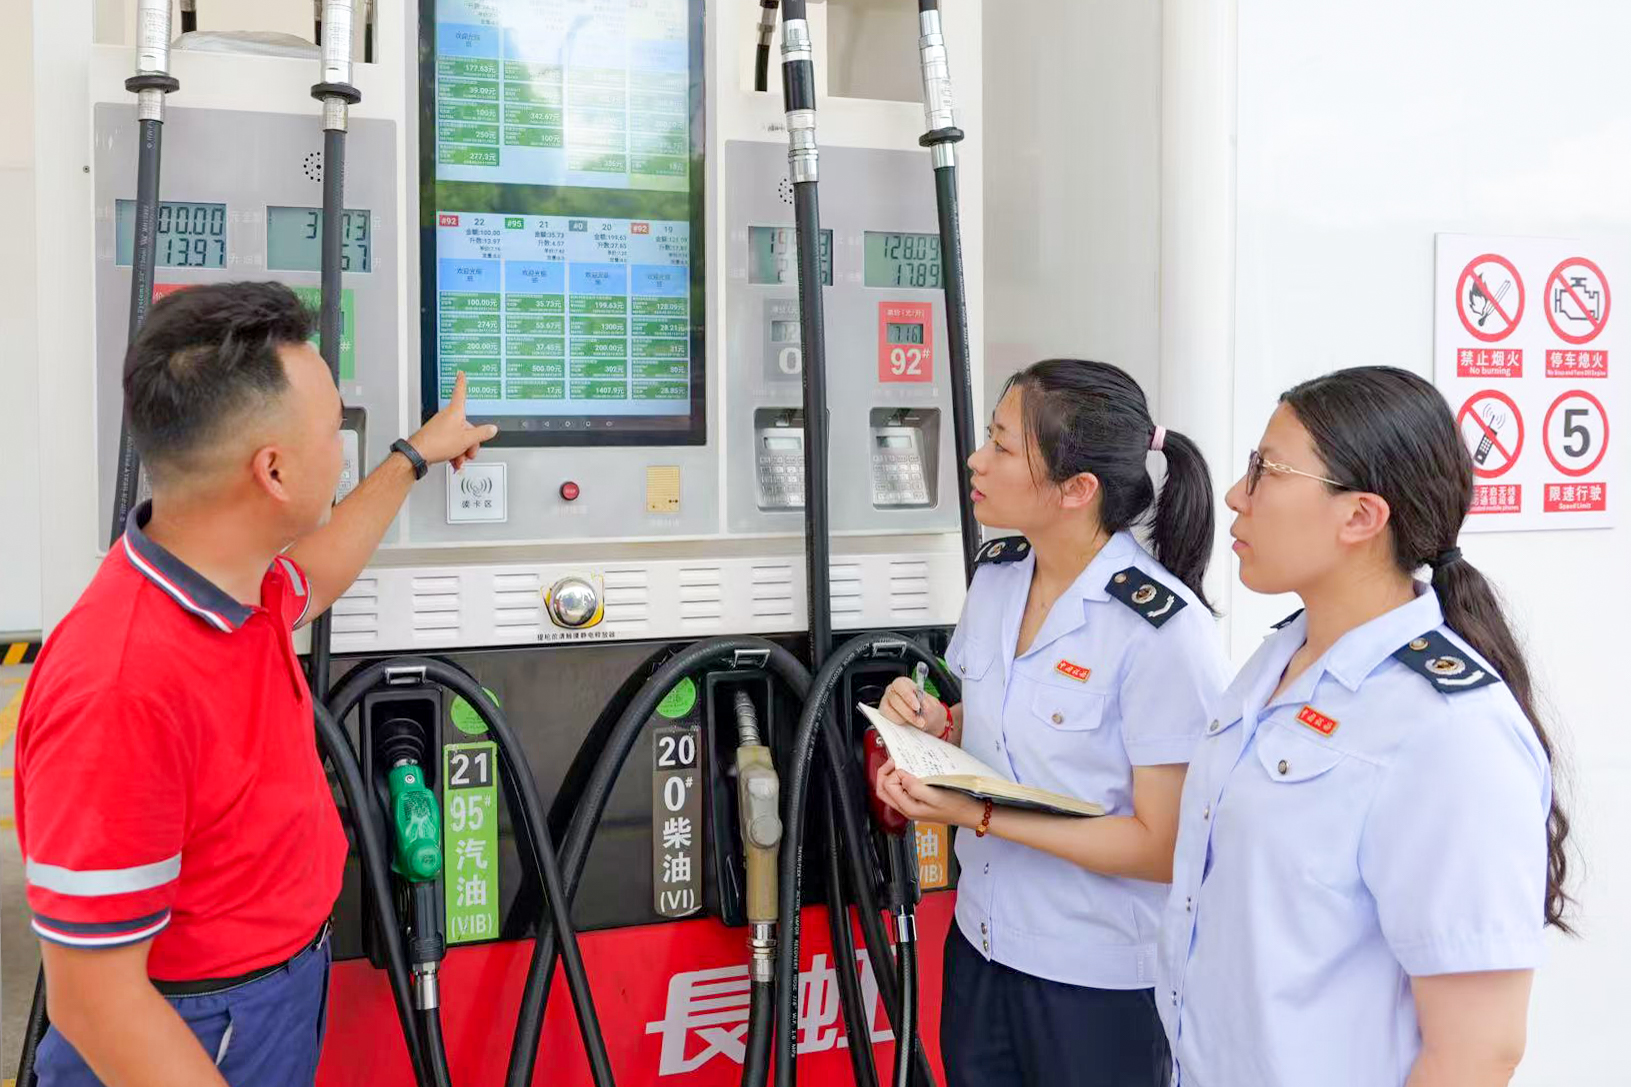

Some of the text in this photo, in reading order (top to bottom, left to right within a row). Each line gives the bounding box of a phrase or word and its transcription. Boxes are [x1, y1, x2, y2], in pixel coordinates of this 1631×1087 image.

[474, 218, 485, 226] 22
[602, 223, 612, 231] 20
[167, 238, 224, 266] 13.97
[885, 236, 940, 261] 128.09
[897, 263, 940, 287] 17.89
[467, 298, 498, 307] 100.00元
[536, 300, 562, 308] 35.73元
[477, 320, 498, 328] 274元
[466, 342, 498, 350] 200.00元
[1461, 350, 1519, 366] 禁止烟火
[1551, 351, 1603, 368] 停车熄火
[482, 364, 498, 372] 20元
[532, 364, 562, 372] 500.00元
[1470, 367, 1511, 377] No burning
[547, 386, 562, 394] 17元
[1563, 409, 1591, 458] 5
[1549, 485, 1602, 502] 限速行驶
[658, 735, 695, 767] 20
[450, 752, 487, 785] 21
[664, 776, 694, 811] 0#
[450, 794, 491, 832] 95#
[662, 817, 692, 883] 柴油
[456, 838, 488, 907] 汽油
[660, 889, 694, 912] (VI)
